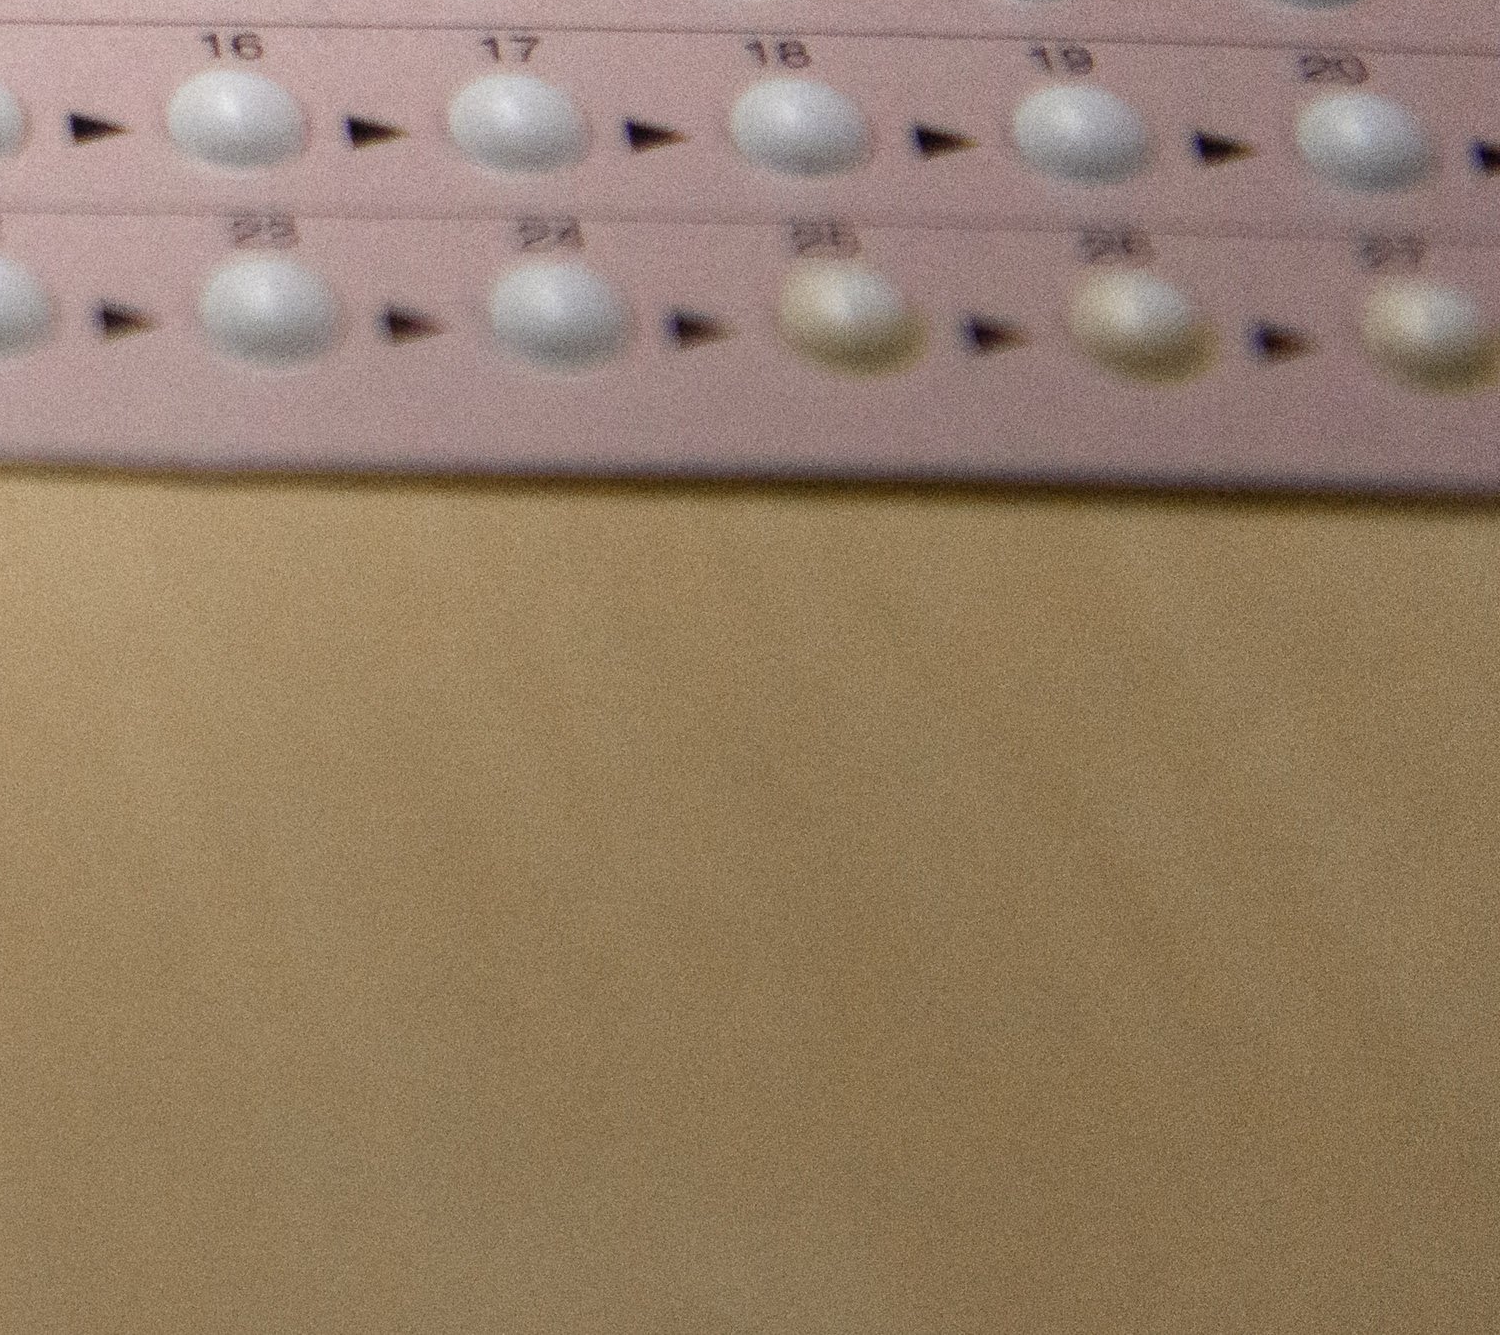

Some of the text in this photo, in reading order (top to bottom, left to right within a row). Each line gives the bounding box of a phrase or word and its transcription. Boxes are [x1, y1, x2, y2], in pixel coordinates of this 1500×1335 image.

[201, 32, 265, 61] 16
[480, 36, 540, 62] 17
[746, 40, 811, 69] 18
[1030, 44, 1093, 75] 19
[1302, 54, 1368, 80] 20
